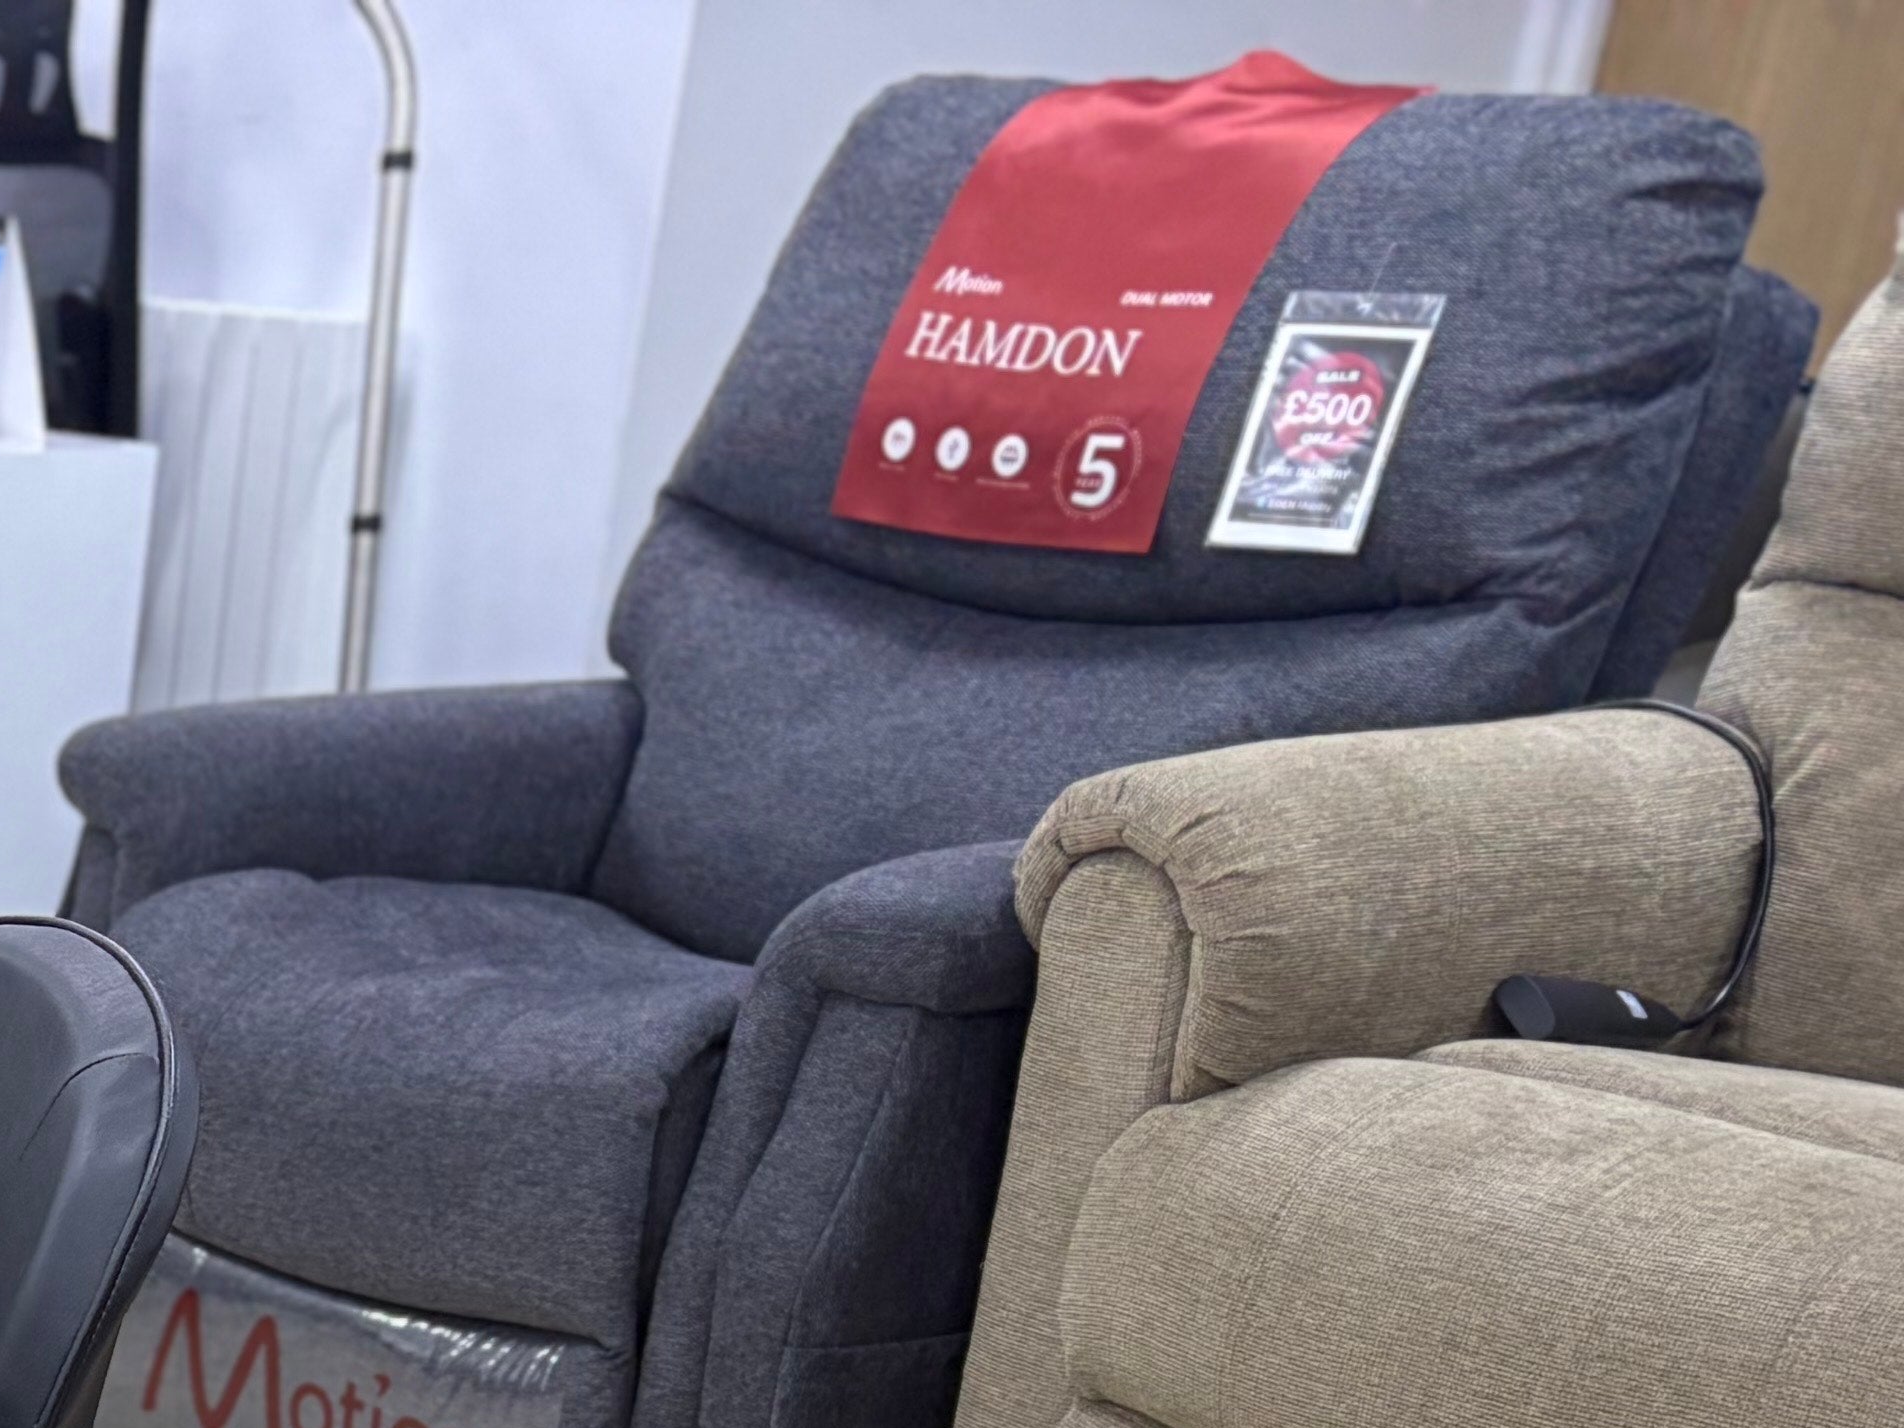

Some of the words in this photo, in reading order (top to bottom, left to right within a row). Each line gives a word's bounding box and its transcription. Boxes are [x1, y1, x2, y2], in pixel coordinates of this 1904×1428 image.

[934, 265, 1004, 295] Motion
[1120, 291, 1158, 306] DUAL
[1160, 291, 1213, 306] MOTOR
[904, 311, 1142, 377] HAMDON
[1316, 371, 1360, 384] SALE
[1284, 390, 1372, 425] £500
[1070, 433, 1125, 507] 5
